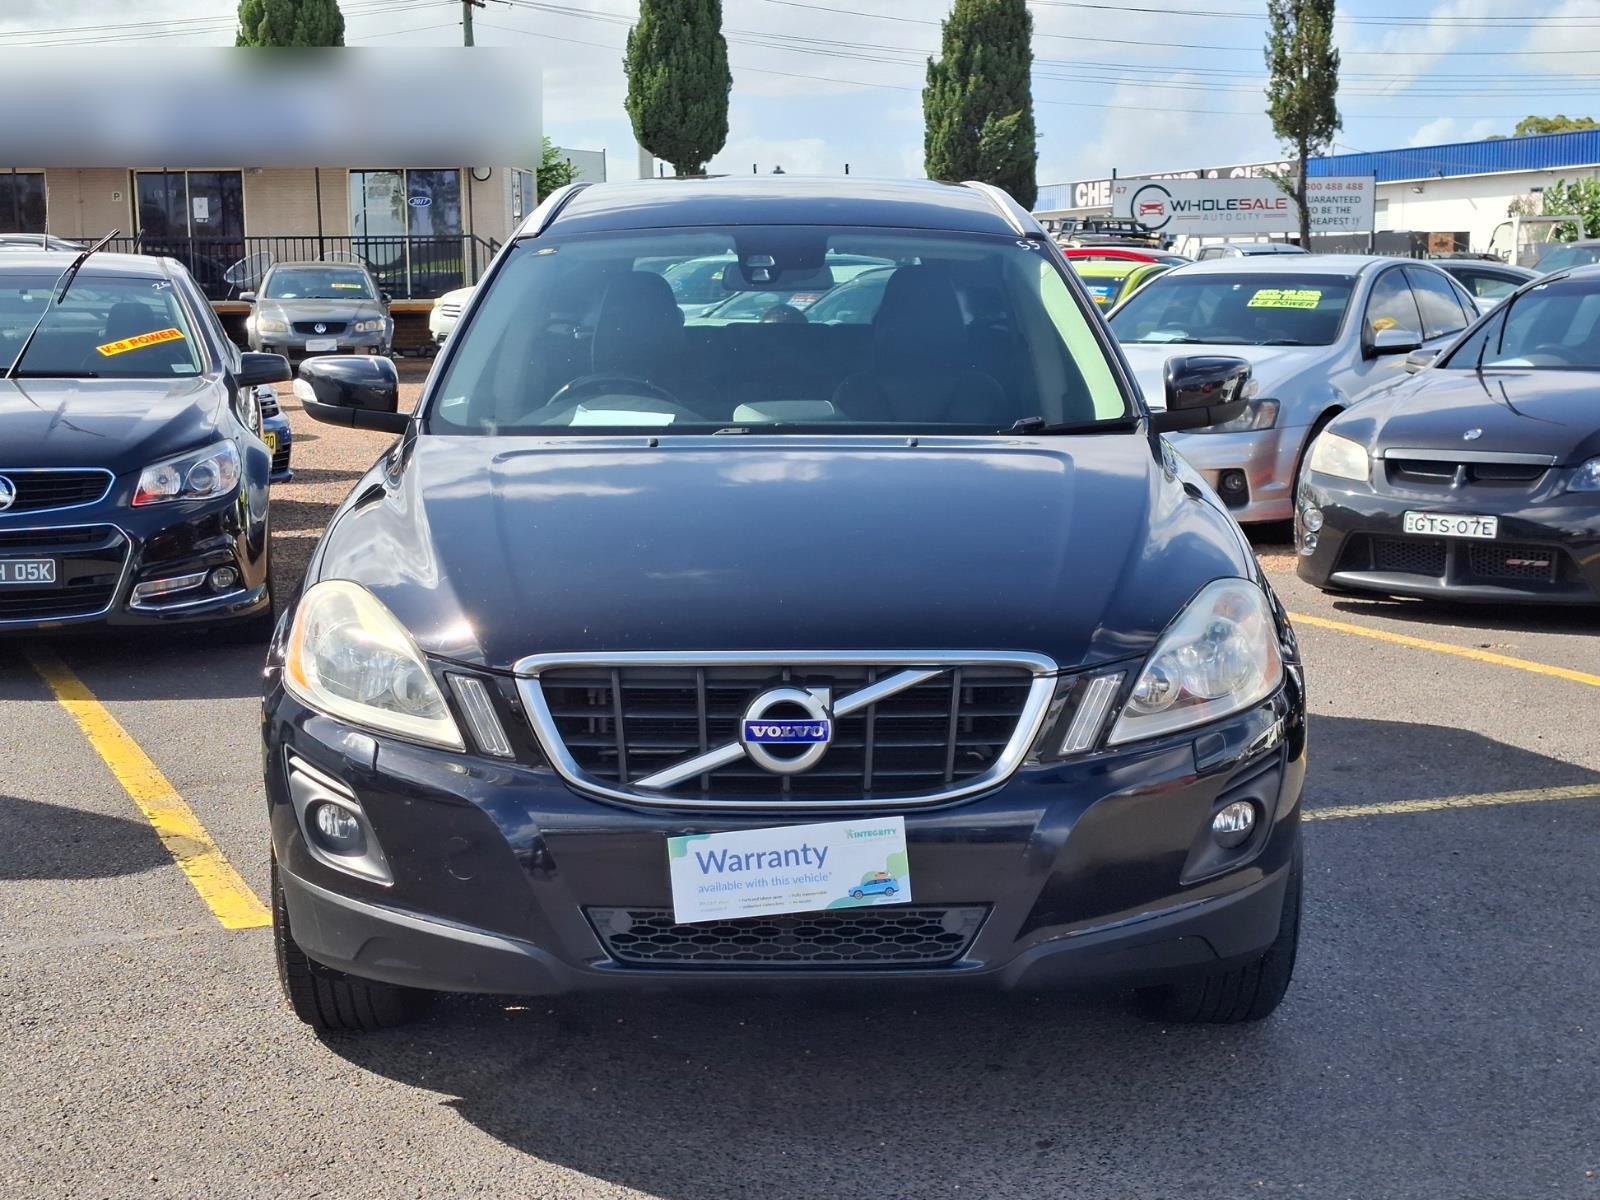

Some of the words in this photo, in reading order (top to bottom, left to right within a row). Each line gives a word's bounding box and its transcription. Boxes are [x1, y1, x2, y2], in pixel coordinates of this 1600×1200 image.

[1115, 186, 1127, 195] 47
[1325, 182, 1343, 191] 488
[1345, 182, 1363, 191] 488
[1075, 181, 1113, 207] CHE
[1307, 195, 1361, 204] UARANTEED
[1170, 198, 1288, 211] WHOLESALE
[1321, 206, 1333, 214] BE
[1336, 206, 1352, 214] THE
[1203, 213, 1233, 221] AUTO
[1237, 212, 1260, 220] CITY
[1310, 217, 1350, 225] HEAPEST
[101, 342, 126, 354] V-8
[129, 329, 180, 347] POWER
[15, 563, 52, 580] 05K
[750, 725, 825, 738] VOLVO
[695, 843, 829, 875] Warranty
[698, 880, 743, 894] available
[746, 876, 768, 889] with
[771, 875, 790, 887] this
